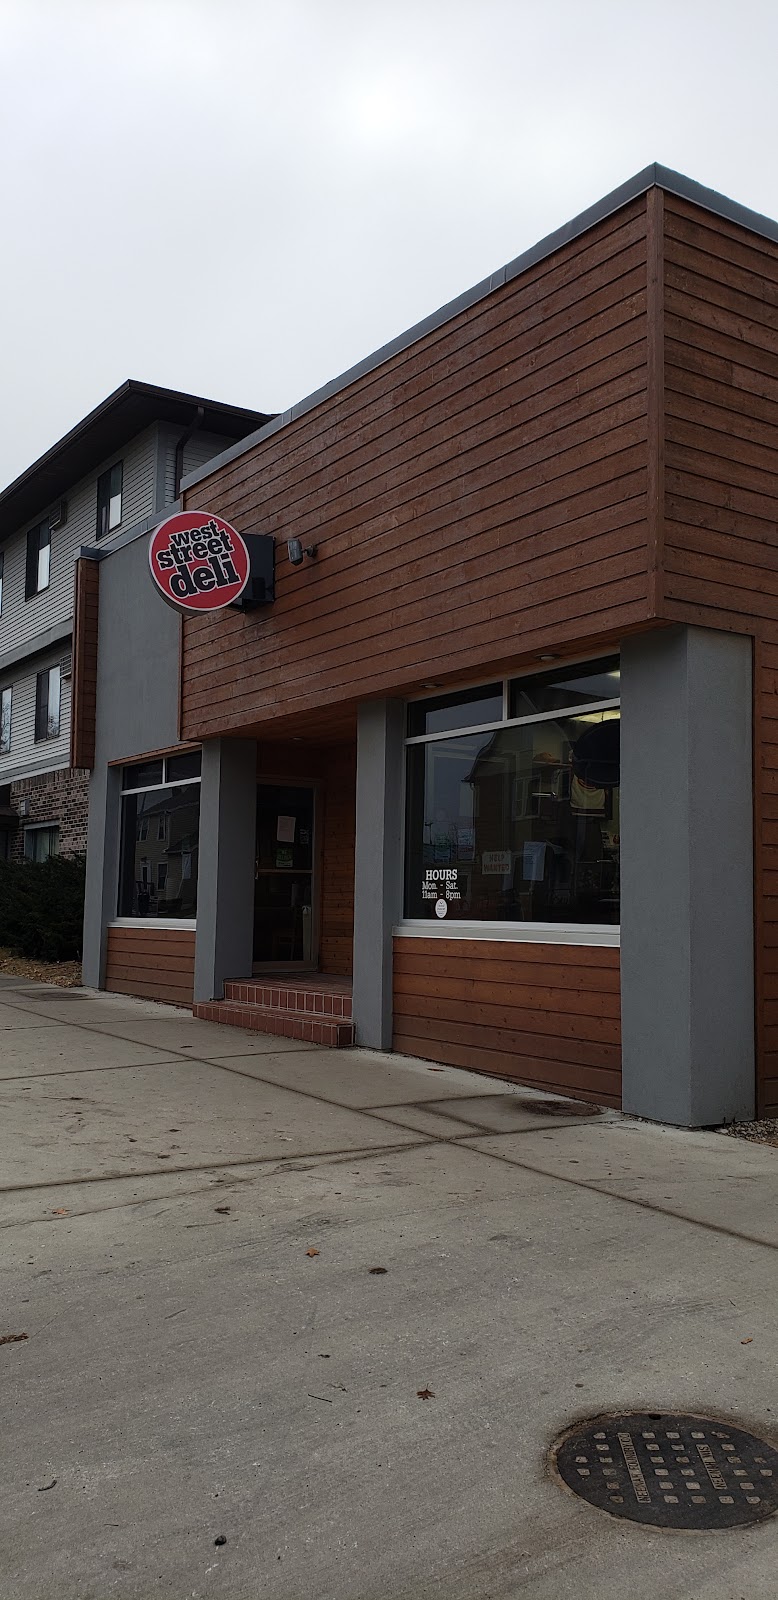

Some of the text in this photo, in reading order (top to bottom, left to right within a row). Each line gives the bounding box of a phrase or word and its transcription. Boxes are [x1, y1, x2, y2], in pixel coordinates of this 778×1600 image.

[169, 520, 219, 547] west
[156, 529, 235, 570] street
[169, 553, 241, 598] deli
[425, 869, 458, 881] HOURS
[422, 881, 438, 890] Mon.
[445, 881, 458, 890] Sat.
[422, 890, 438, 899] 11am
[445, 890, 461, 901] 8pm
